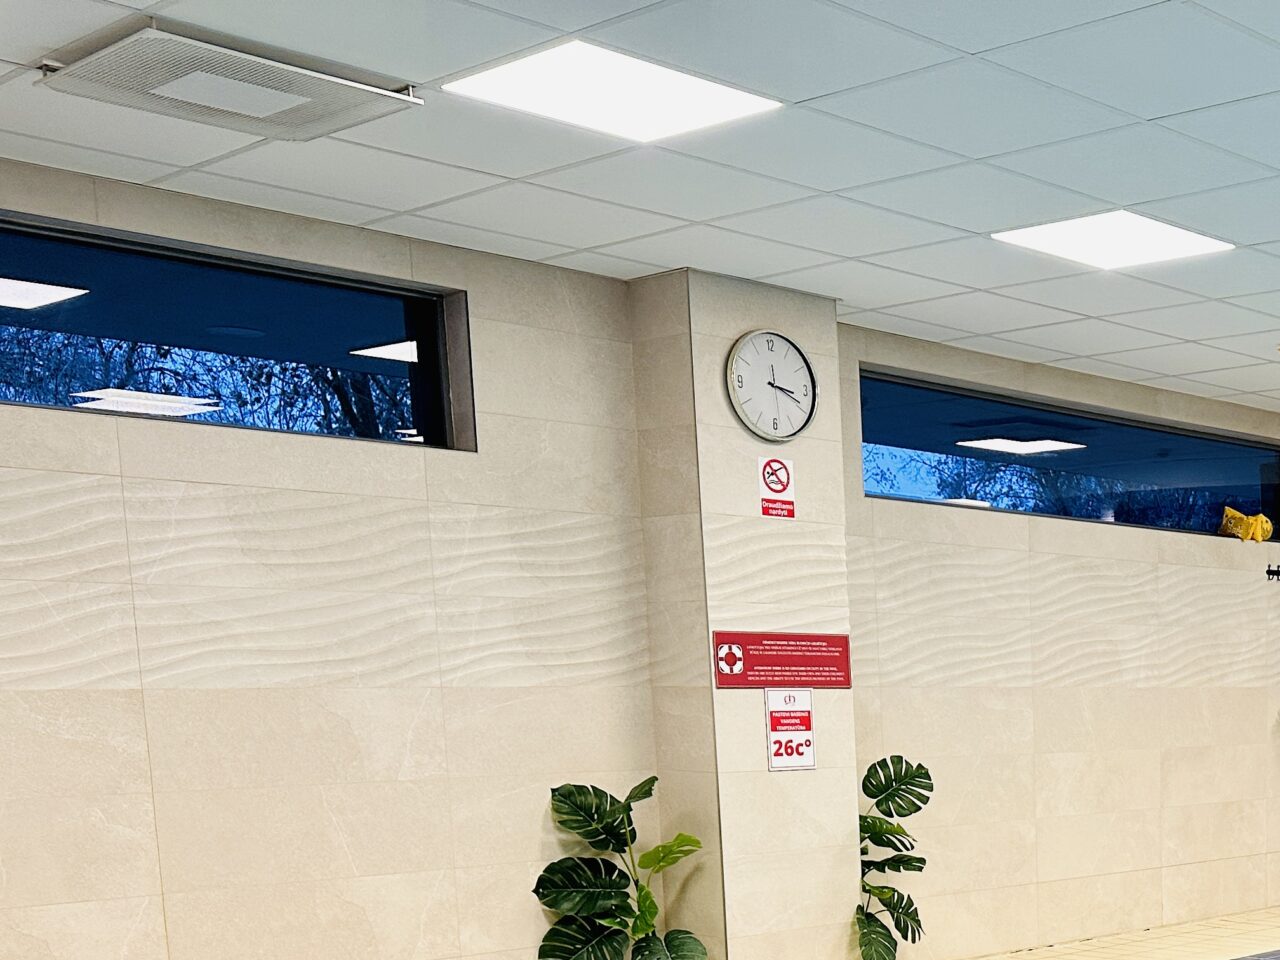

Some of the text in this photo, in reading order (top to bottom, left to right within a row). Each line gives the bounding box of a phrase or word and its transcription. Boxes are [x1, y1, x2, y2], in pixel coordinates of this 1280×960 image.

[766, 338, 775, 352] 12
[737, 374, 744, 389] 9
[802, 385, 808, 397] 3
[772, 417, 778, 431] 6
